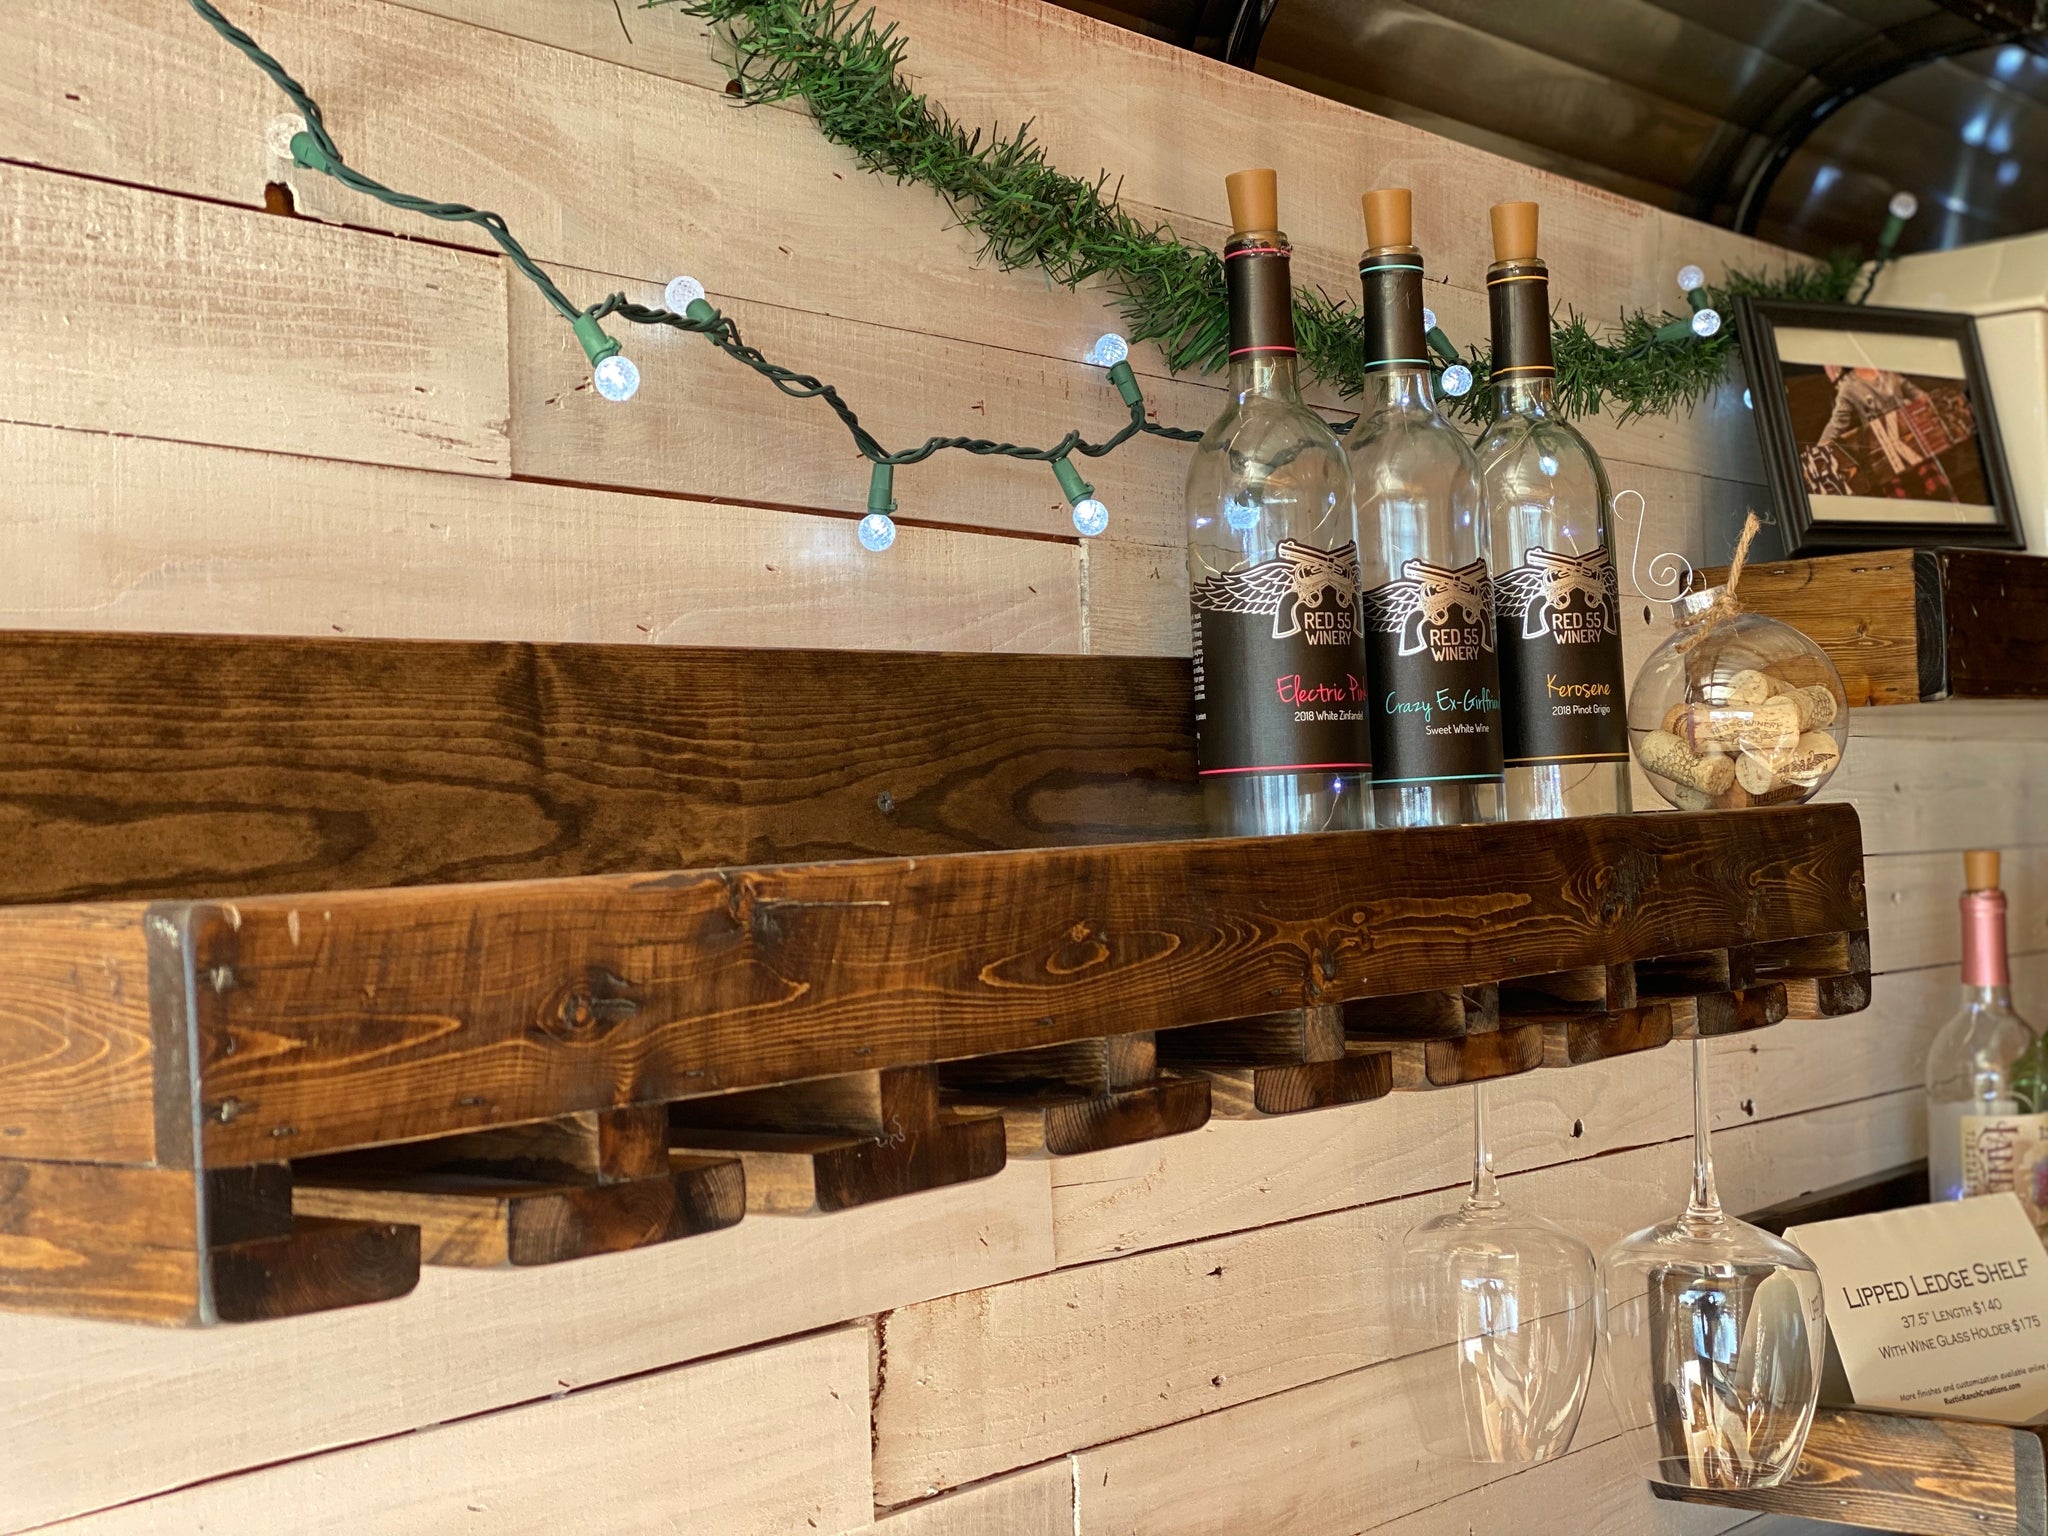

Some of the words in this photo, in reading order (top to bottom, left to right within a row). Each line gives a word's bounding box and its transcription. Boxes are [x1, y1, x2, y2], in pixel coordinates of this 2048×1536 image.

[1304, 611, 1334, 630] RED
[1337, 611, 1352, 630] 55
[1551, 612, 1583, 630] RED
[1585, 611, 1602, 629] 55
[1305, 630, 1352, 646] WINERY
[1429, 628, 1460, 646] RED
[1463, 627, 1479, 645] 55
[1553, 629, 1602, 645] WINERY
[1430, 645, 1480, 662] WINERY
[1276, 674, 1347, 708] Electric
[1546, 673, 1612, 699] Kerosene
[1294, 710, 1315, 722] 2018
[1315, 709, 1339, 721] White
[1385, 691, 1433, 723] Crazy
[1552, 705, 1572, 716] 2018
[1572, 704, 1592, 715] Pinot
[1593, 704, 1611, 717] Grigio
[1425, 725, 1453, 736] Sweet
[1453, 723, 1475, 734] White
[1475, 723, 1490, 733] Wine
[1842, 1281, 1910, 1309] LIPPED
[1909, 1268, 1974, 1297] LEDGE
[1972, 1257, 2029, 1285] SHELF
[1932, 1304, 1973, 1323] LENGTH
[1973, 1298, 2003, 1316] $140
[1878, 1344, 1908, 1360] WITH
[1905, 1338, 1937, 1354] WINE
[1936, 1330, 1971, 1348] GLASS
[1969, 1322, 2013, 1341] HOLDER
[2011, 1315, 2042, 1333] $175
[1899, 1393, 1916, 1402] More
[1917, 1387, 1942, 1399] finishes
[1943, 1383, 1955, 1393] and
[1955, 1374, 2000, 1390] customization
[2000, 1368, 2027, 1380] available
[2027, 1363, 2046, 1374] online
[1943, 1382, 2022, 1405] RusticRanchCreations.com
